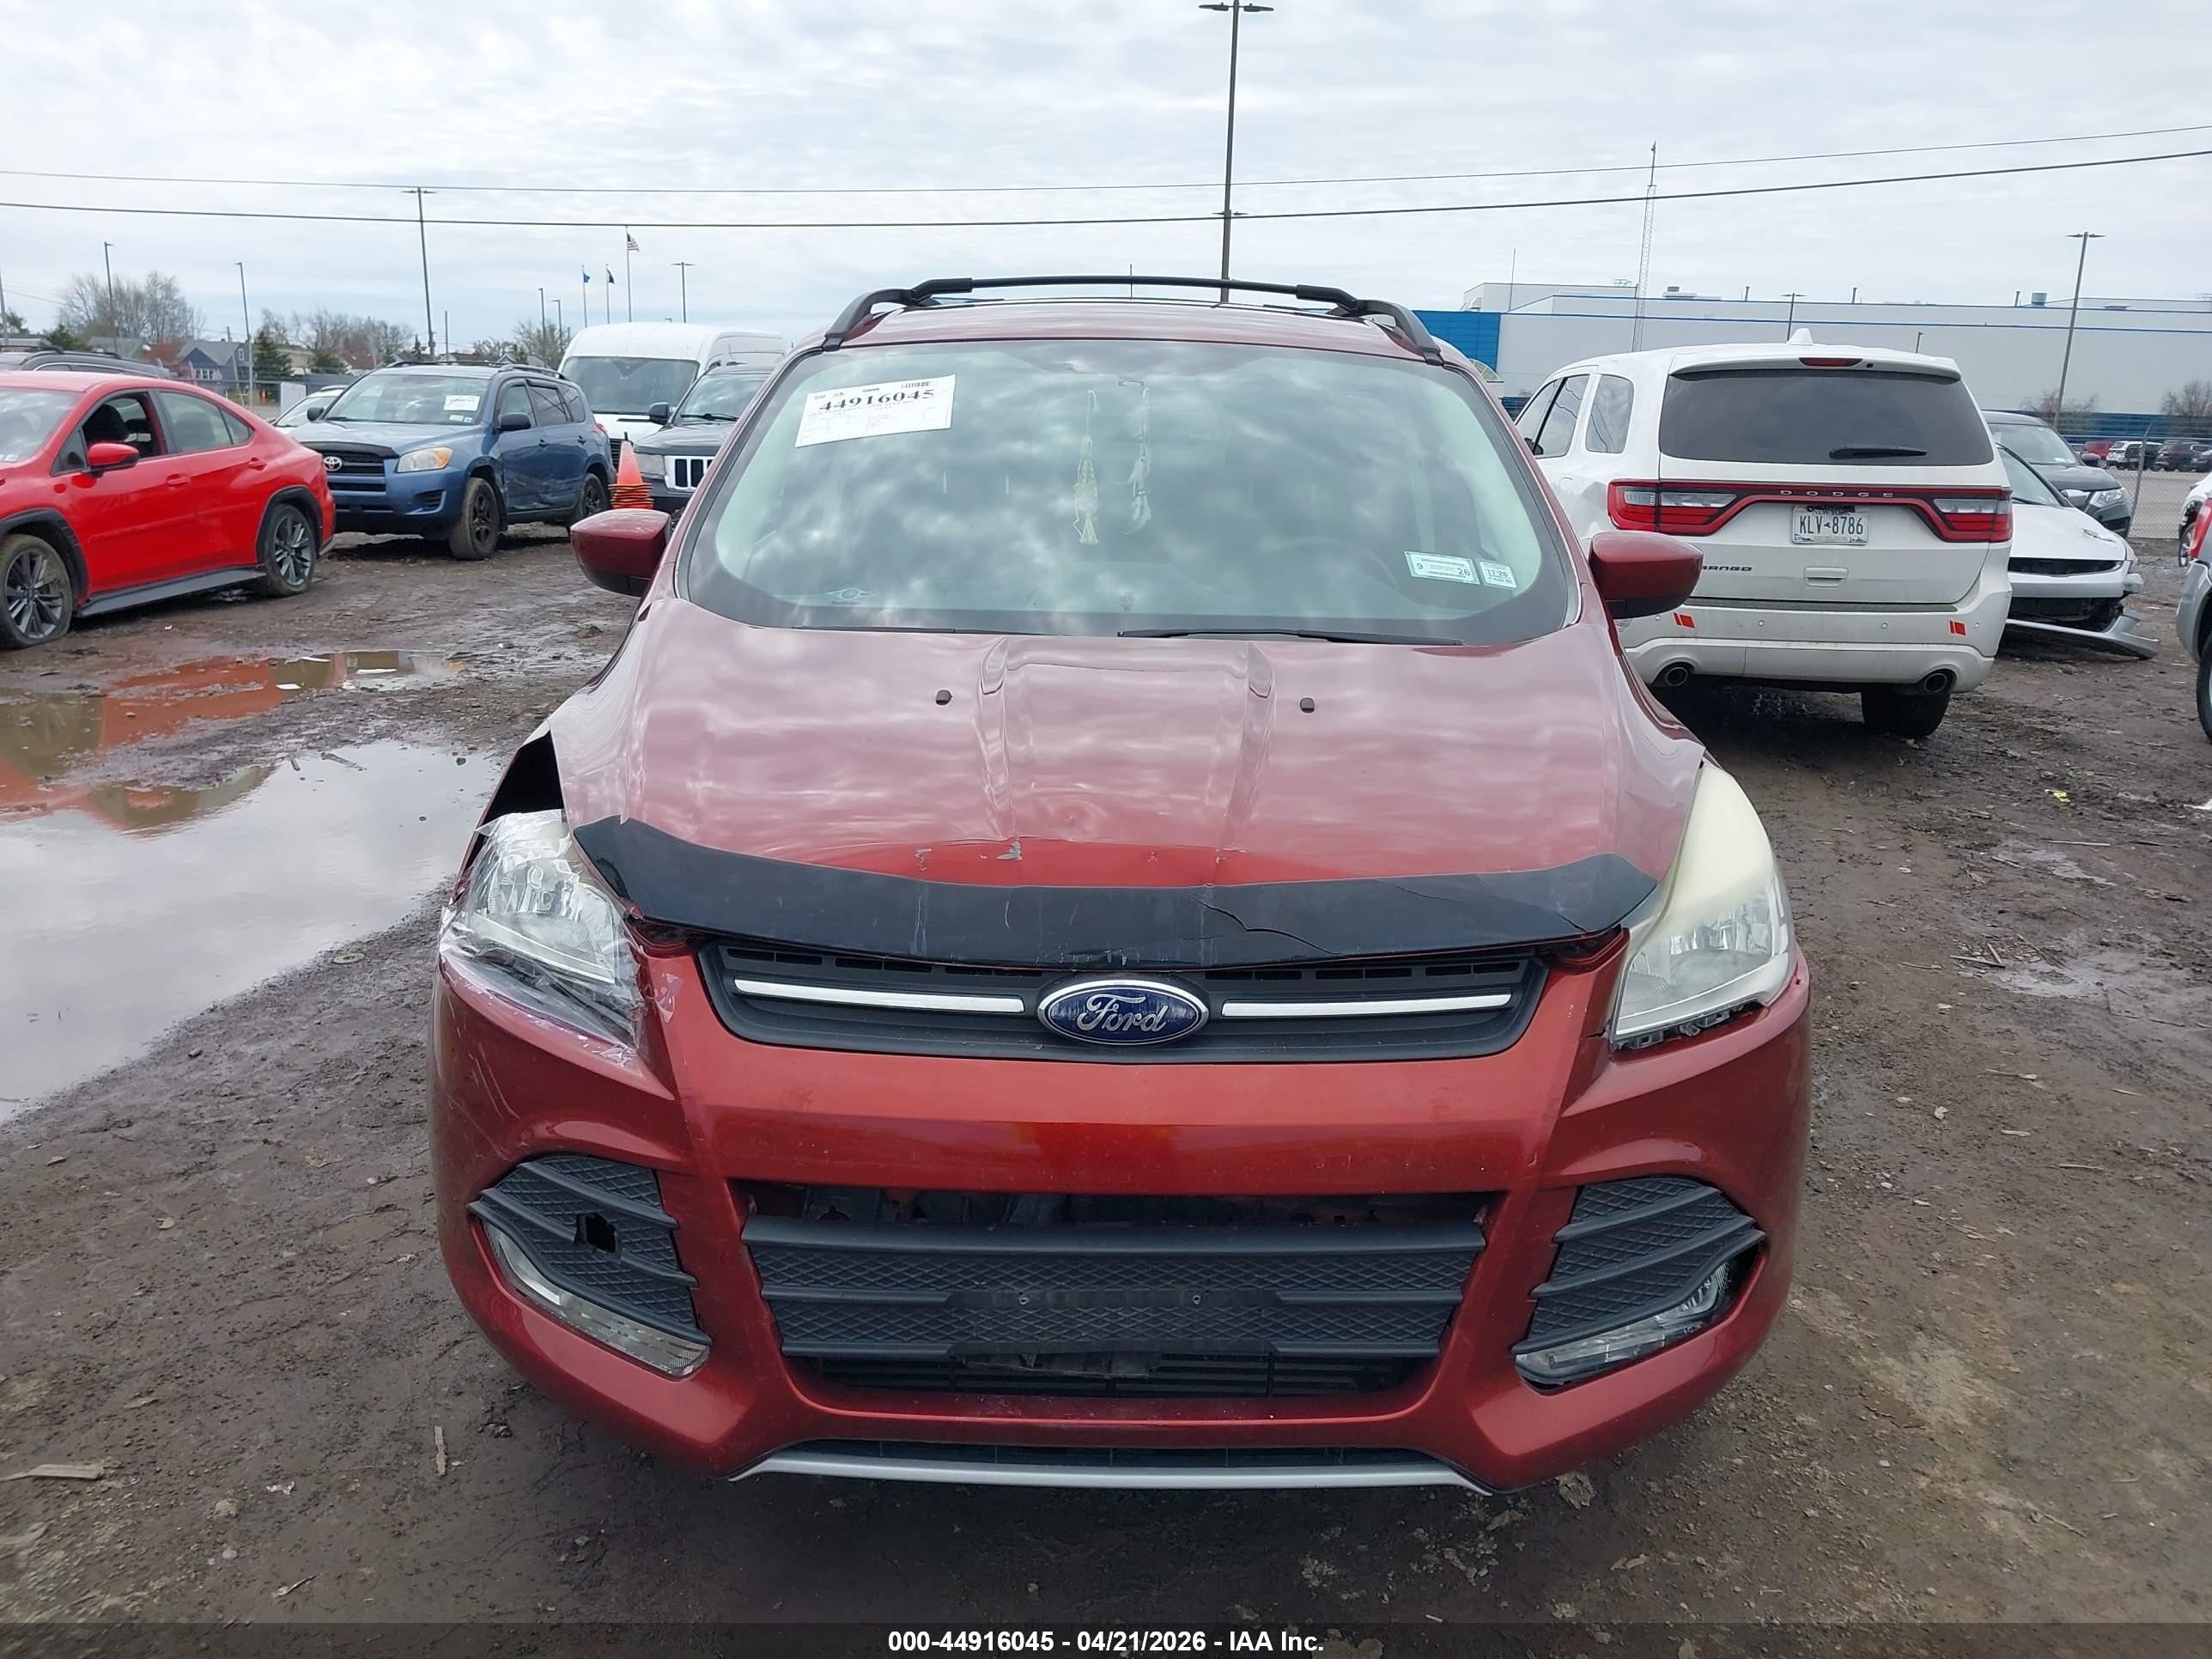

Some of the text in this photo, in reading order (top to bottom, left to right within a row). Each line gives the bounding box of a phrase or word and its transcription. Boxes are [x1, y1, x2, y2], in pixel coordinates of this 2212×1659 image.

[817, 389, 934, 410] 44916045
[1456, 568, 1471, 576] 26
[1076, 994, 1169, 1032] Ford
